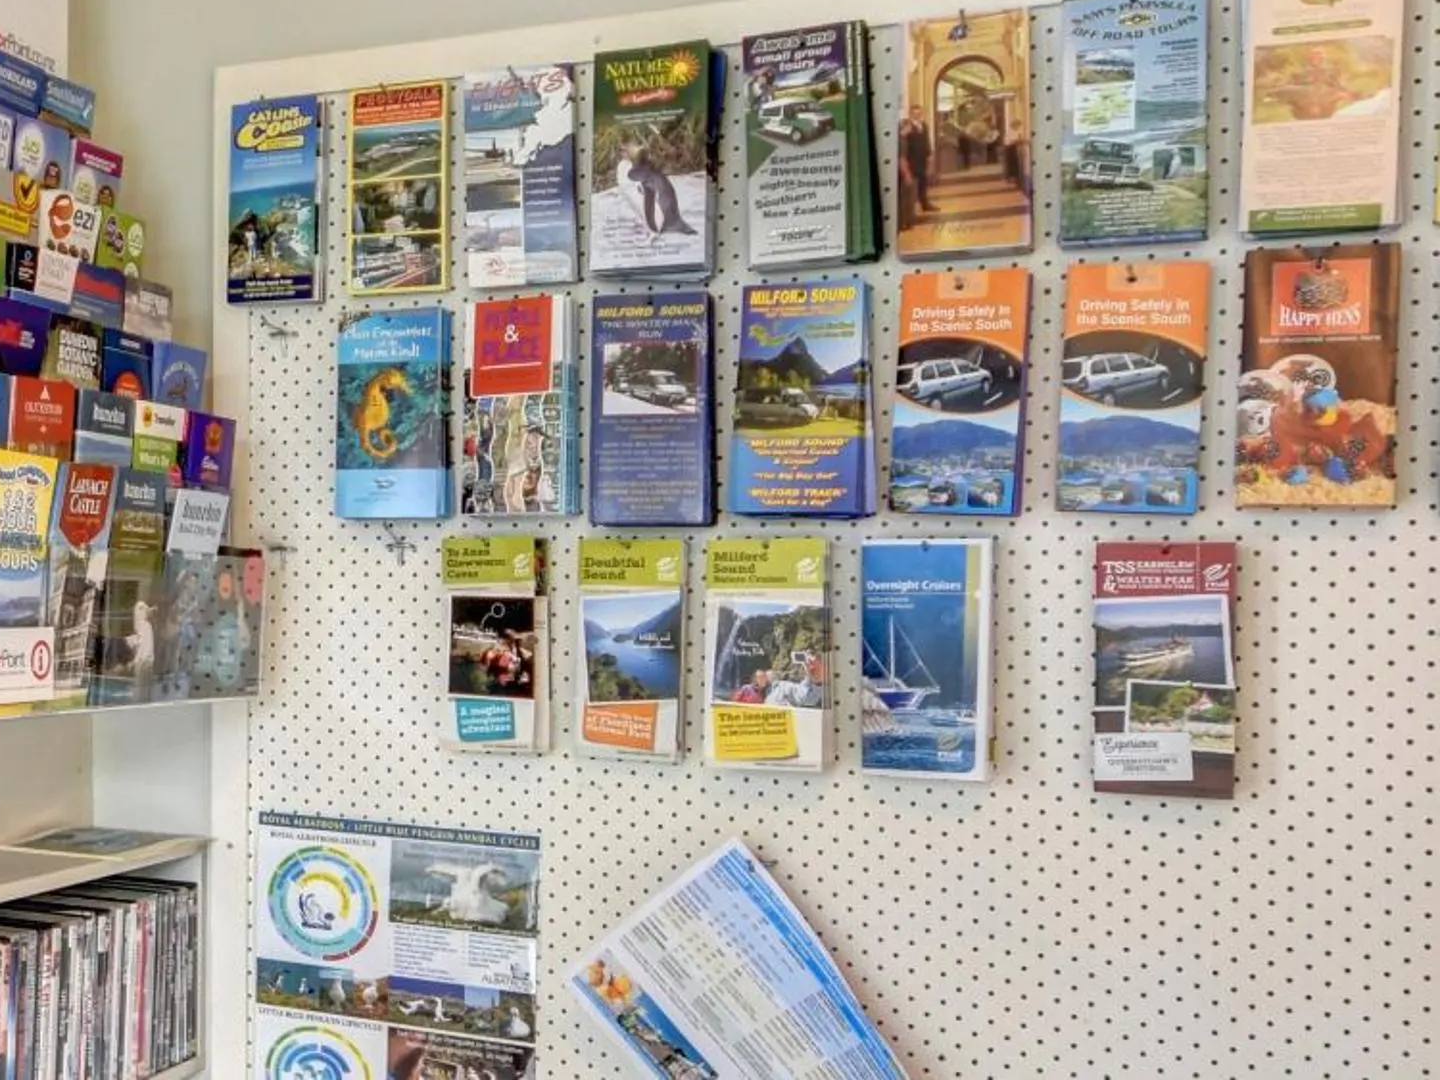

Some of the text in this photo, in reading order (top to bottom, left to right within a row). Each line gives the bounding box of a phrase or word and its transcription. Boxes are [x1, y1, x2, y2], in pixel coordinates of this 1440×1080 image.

[1103, 30, 1144, 40] ROAD
[754, 46, 832, 65] small group
[615, 72, 690, 92] WONDERS
[74, 206, 97, 232] ezi
[750, 286, 856, 306] MILFORD SOUND
[598, 304, 705, 319] MILFORD SOUND
[1080, 299, 1127, 313] Driving
[1131, 299, 1173, 313] Safely
[912, 306, 955, 320] Driving
[959, 306, 996, 319] Safely
[1076, 312, 1192, 325] the Scenic South
[1279, 302, 1361, 327] HAPPY HENS
[909, 319, 1012, 332] the Scenic South
[504, 324, 520, 343] &
[70, 470, 110, 497] LARNACH
[70, 493, 102, 516] CASTLE
[446, 557, 506, 567] Glowworm
[583, 557, 646, 569] Doubtful
[713, 551, 770, 562] Milford
[713, 562, 756, 574] Sound
[1102, 561, 1136, 574] TSS
[583, 570, 627, 580] Sound
[1117, 576, 1162, 584] WALTER
[866, 580, 961, 592] Overnight Cruises
